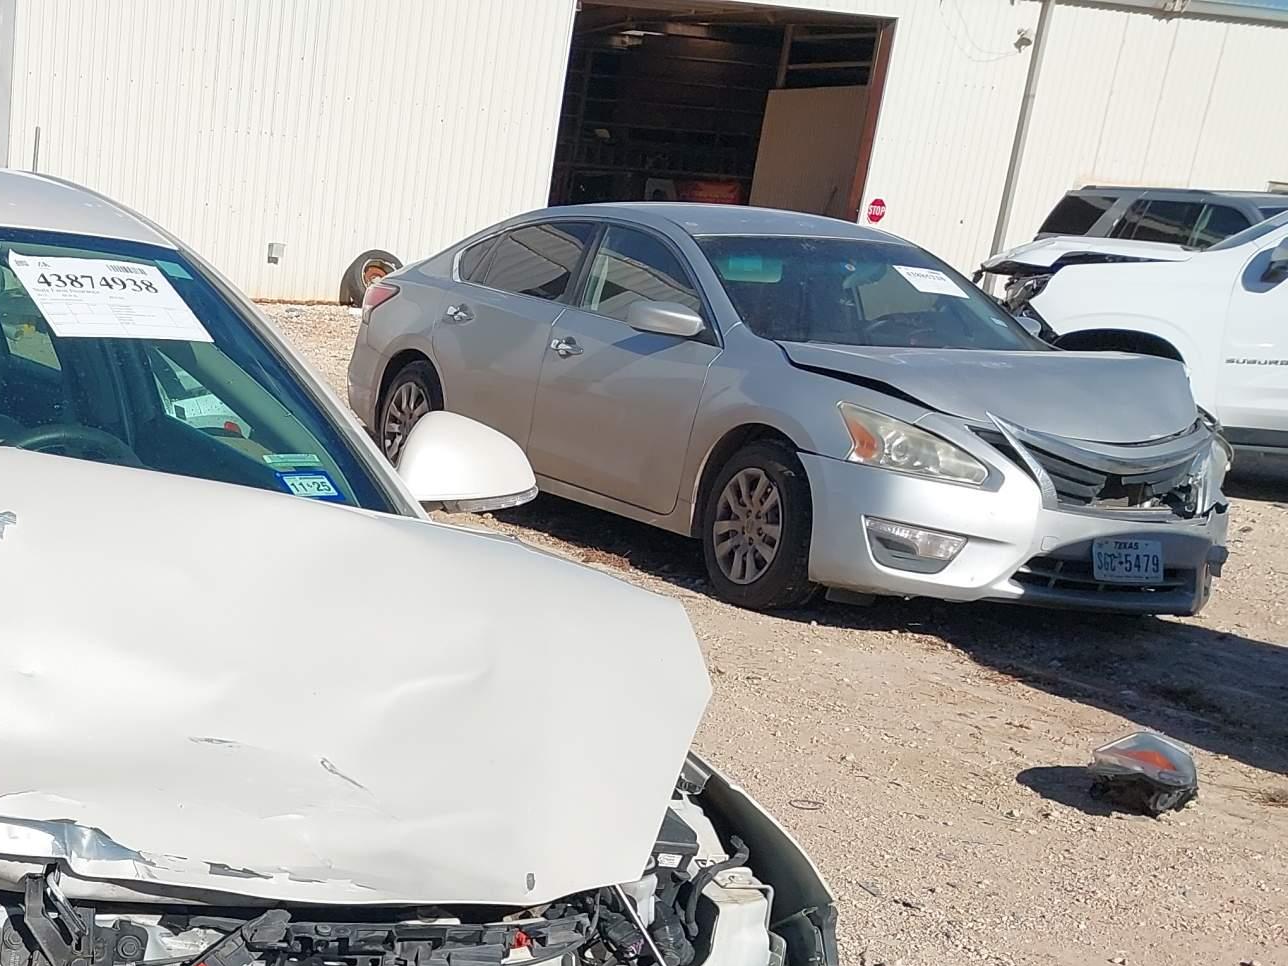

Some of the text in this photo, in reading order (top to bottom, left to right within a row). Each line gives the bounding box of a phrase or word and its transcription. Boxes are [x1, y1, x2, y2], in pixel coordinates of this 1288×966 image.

[868, 205, 886, 216] STOP
[37, 273, 158, 293] 43874938
[1114, 541, 1139, 550] TEXAS
